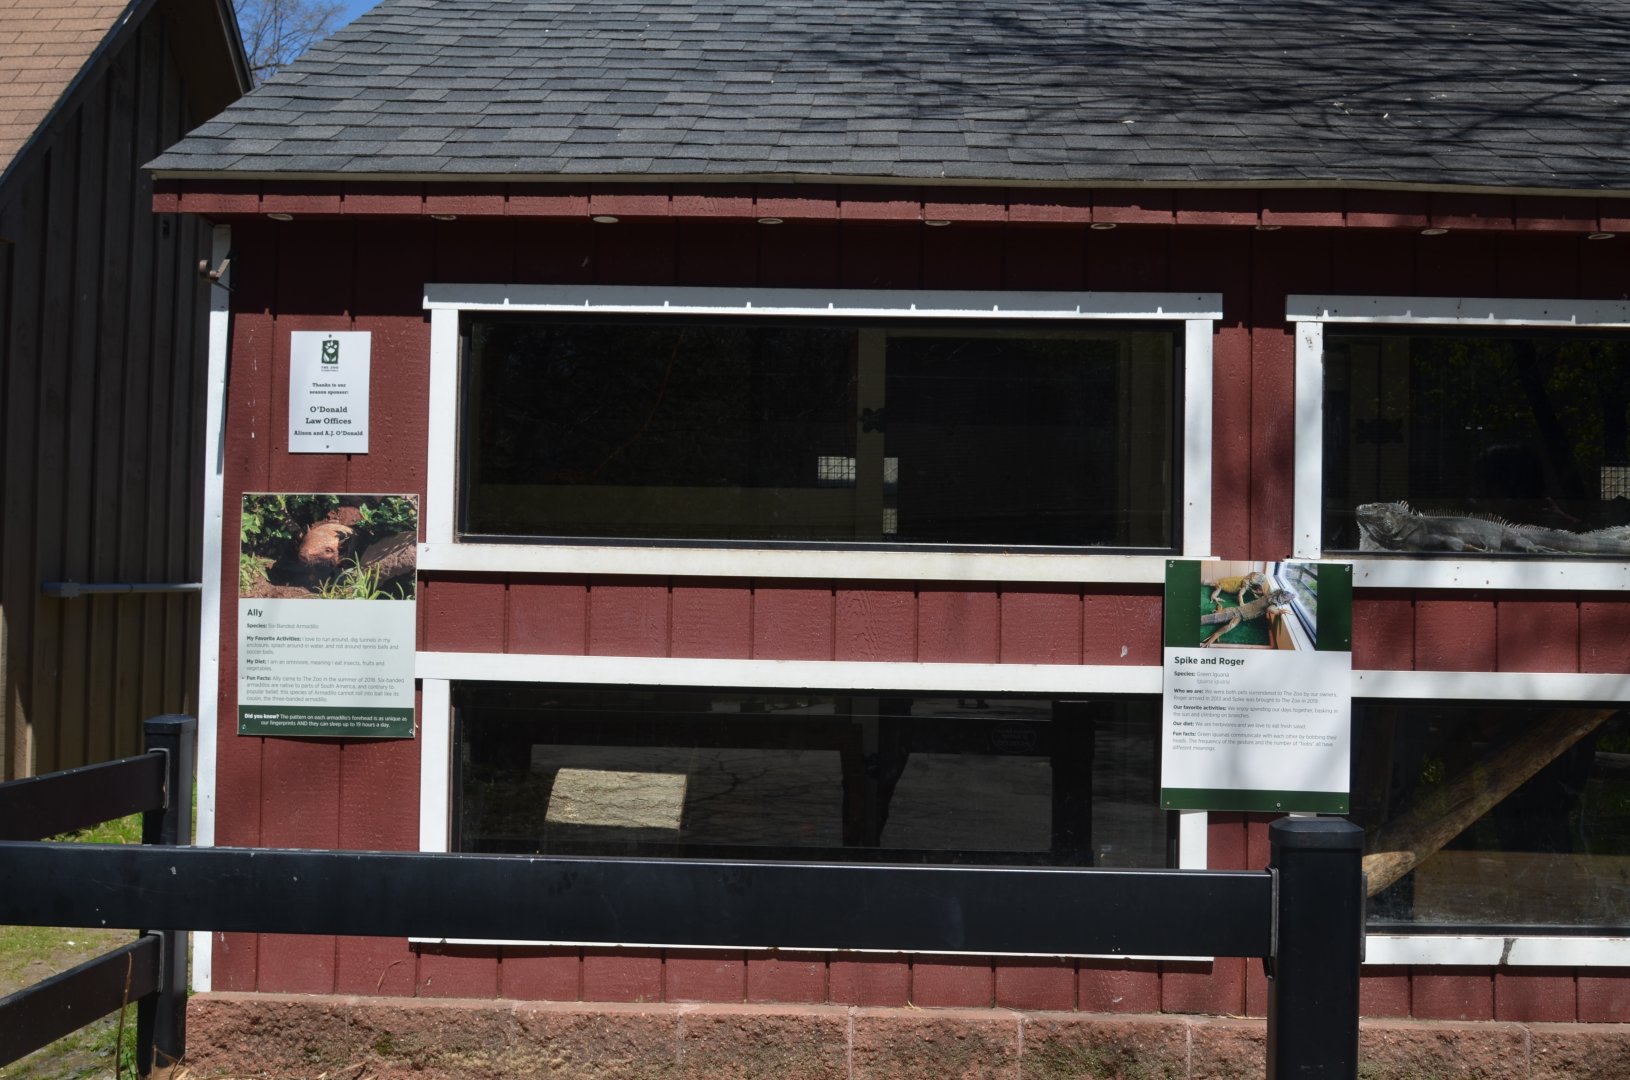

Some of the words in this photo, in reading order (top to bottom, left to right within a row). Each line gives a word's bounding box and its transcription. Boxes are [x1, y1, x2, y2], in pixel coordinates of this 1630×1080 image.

[247, 609, 263, 617] Ally
[1174, 656, 1198, 665] Spike
[1219, 658, 1245, 666] Roger
